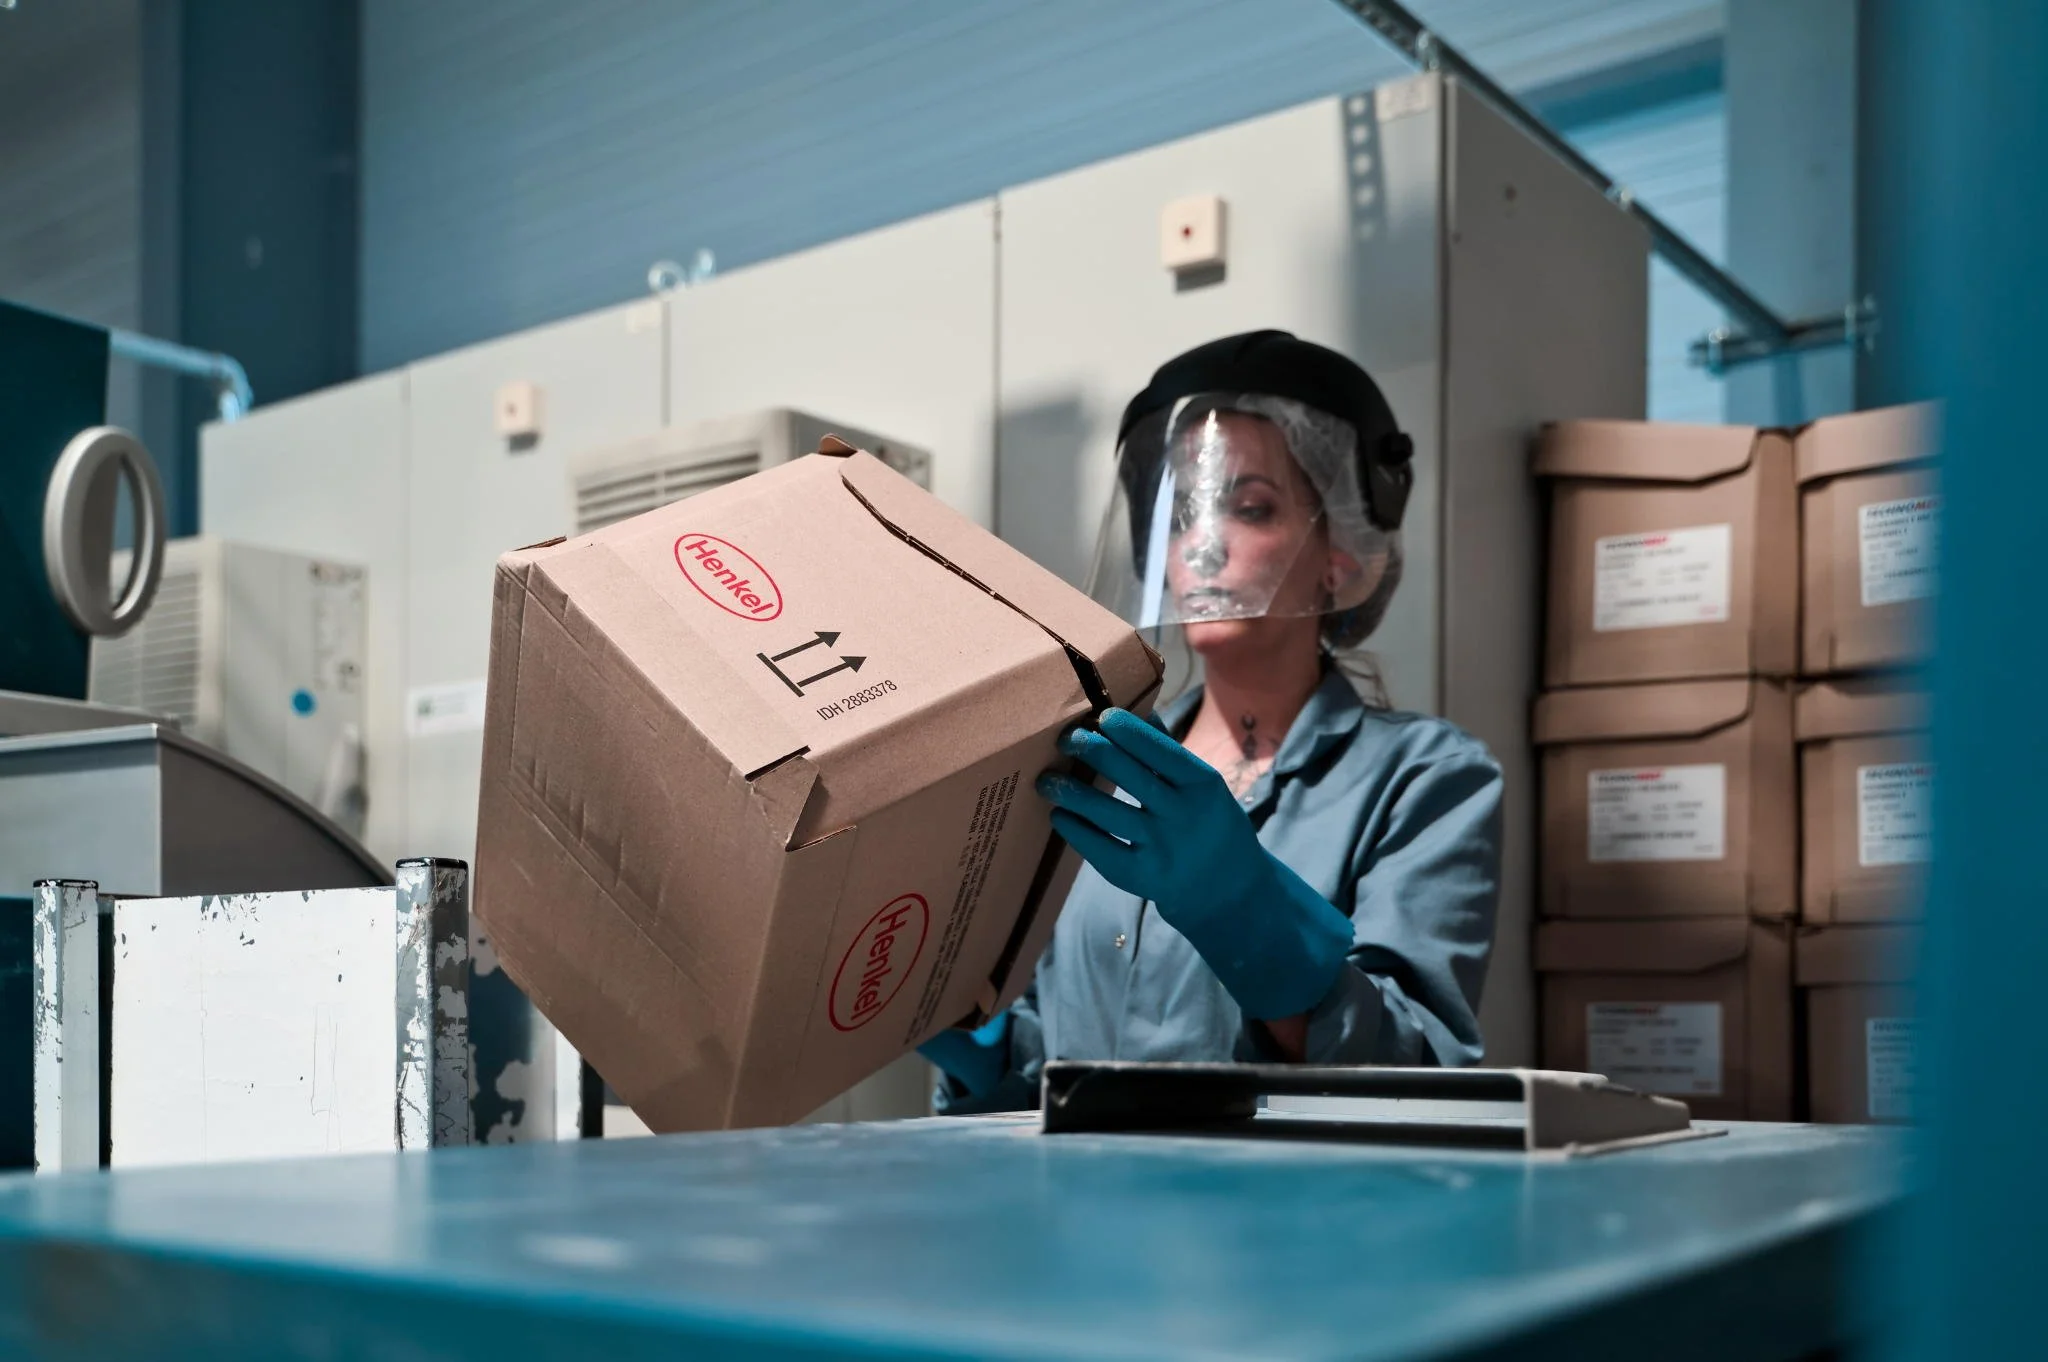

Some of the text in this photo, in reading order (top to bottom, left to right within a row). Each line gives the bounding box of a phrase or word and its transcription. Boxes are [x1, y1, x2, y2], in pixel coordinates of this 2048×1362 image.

[684, 539, 774, 614] Henkel
[816, 679, 897, 721] IDH 2883378
[851, 904, 912, 1020] Henkel
